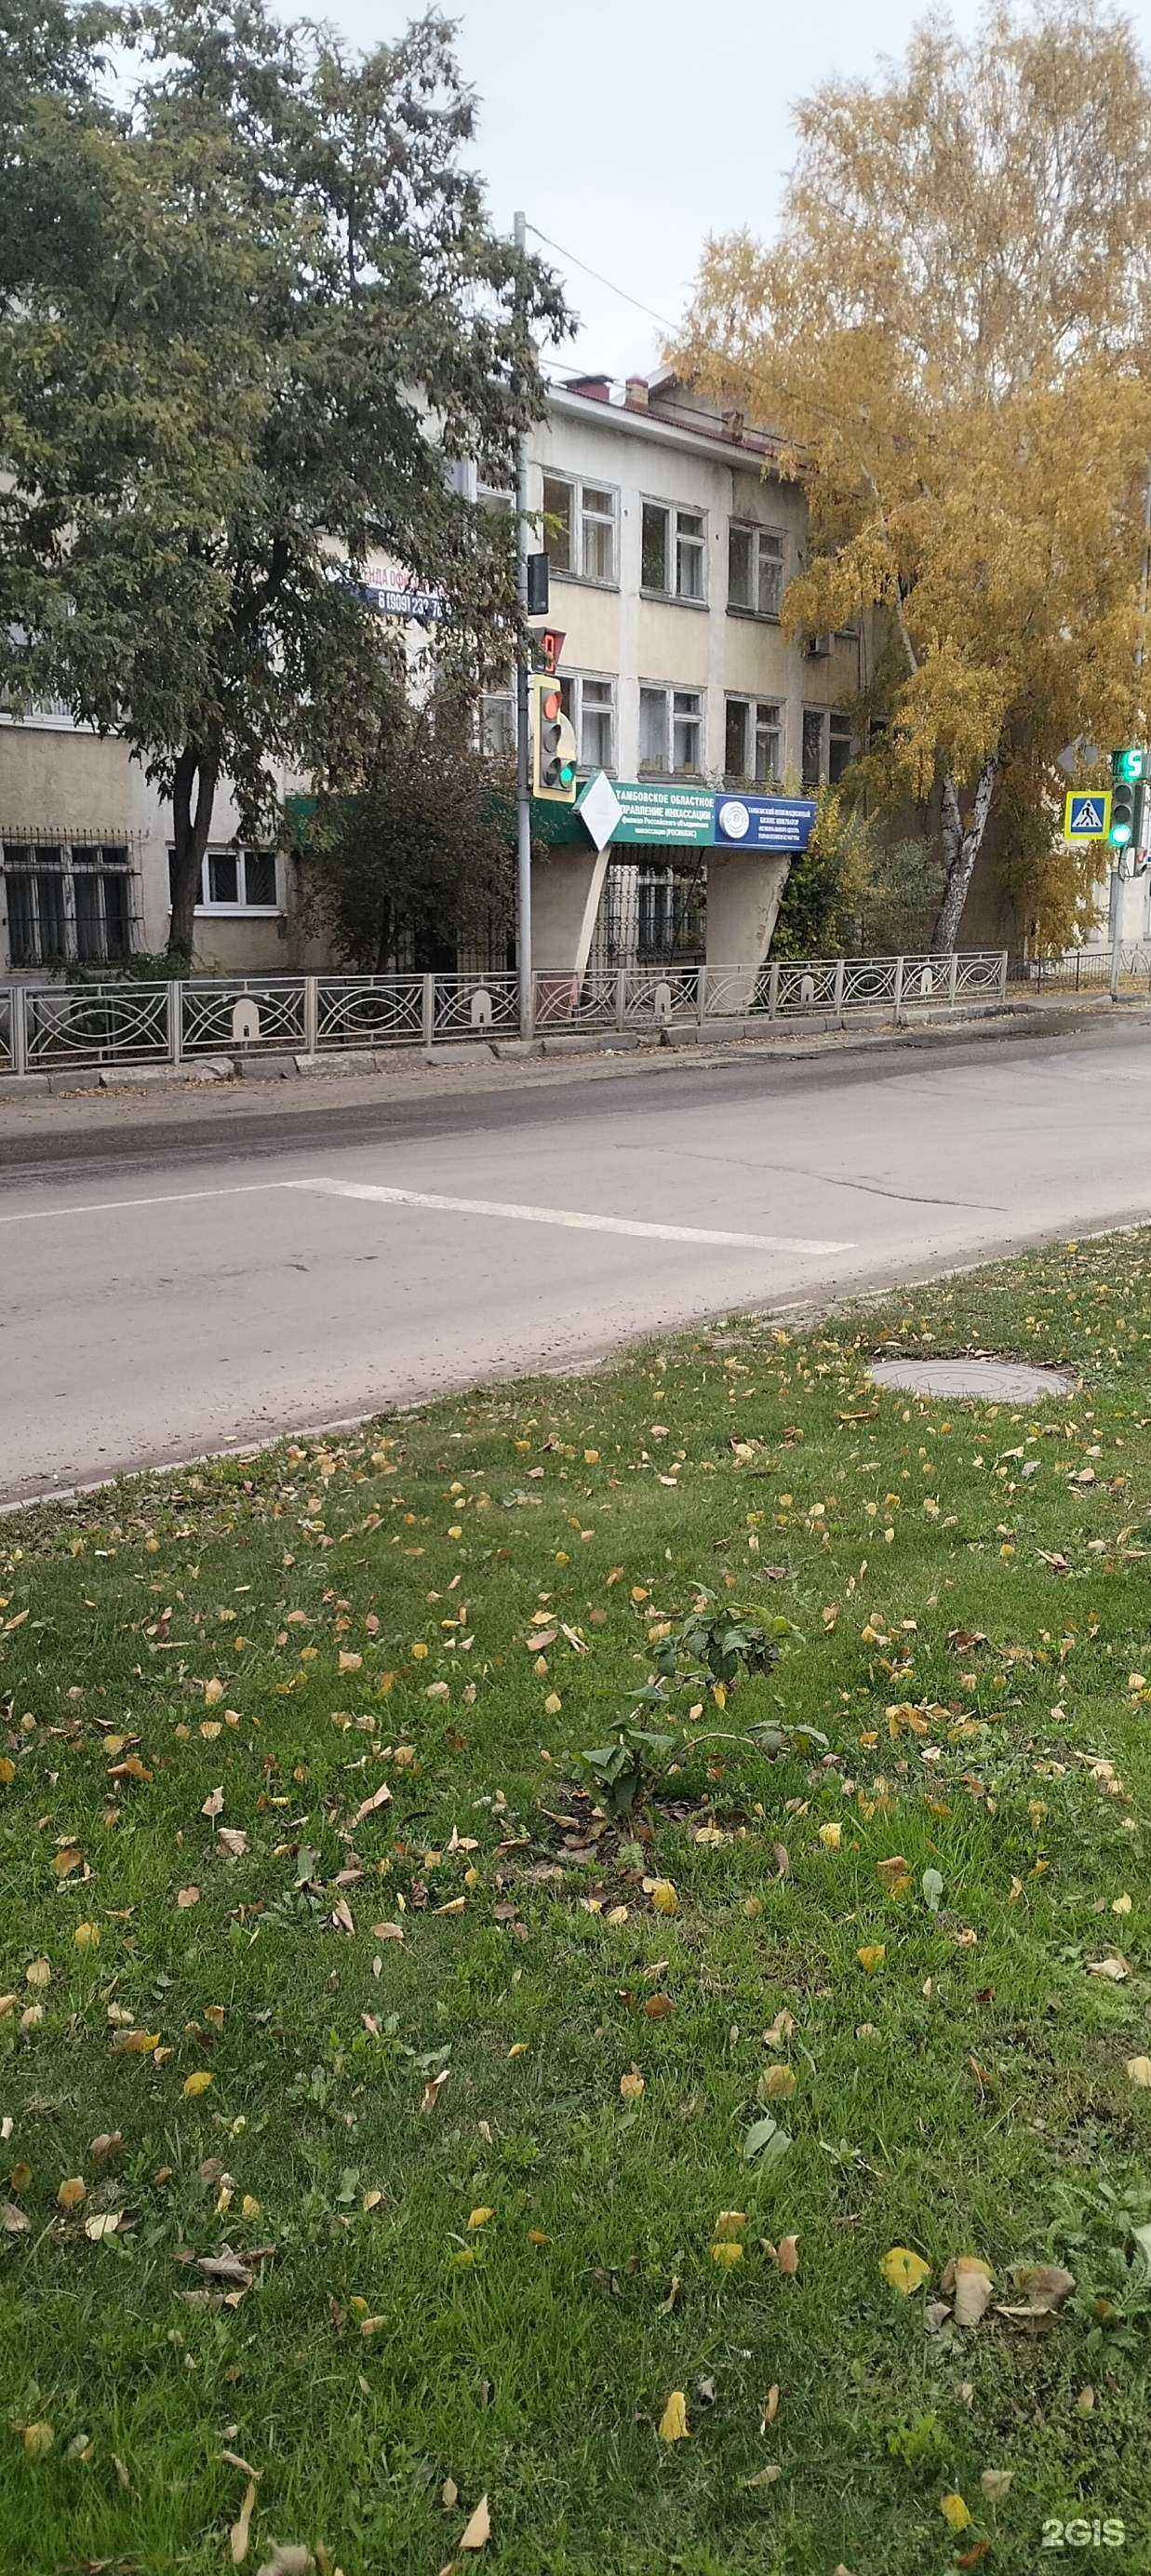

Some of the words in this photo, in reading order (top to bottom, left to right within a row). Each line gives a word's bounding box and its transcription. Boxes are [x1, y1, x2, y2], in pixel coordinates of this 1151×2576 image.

[386, 592, 411, 612] (909)
[1126, 750, 1144, 776] 5
[615, 789, 669, 804] ТАМБОВСКОЕ
[670, 795, 715, 808] ОБЛАСТНОЕ
[618, 804, 664, 817] ПРАВЛЕНИЕ
[664, 809, 711, 821] ИНКАССАЦИИ
